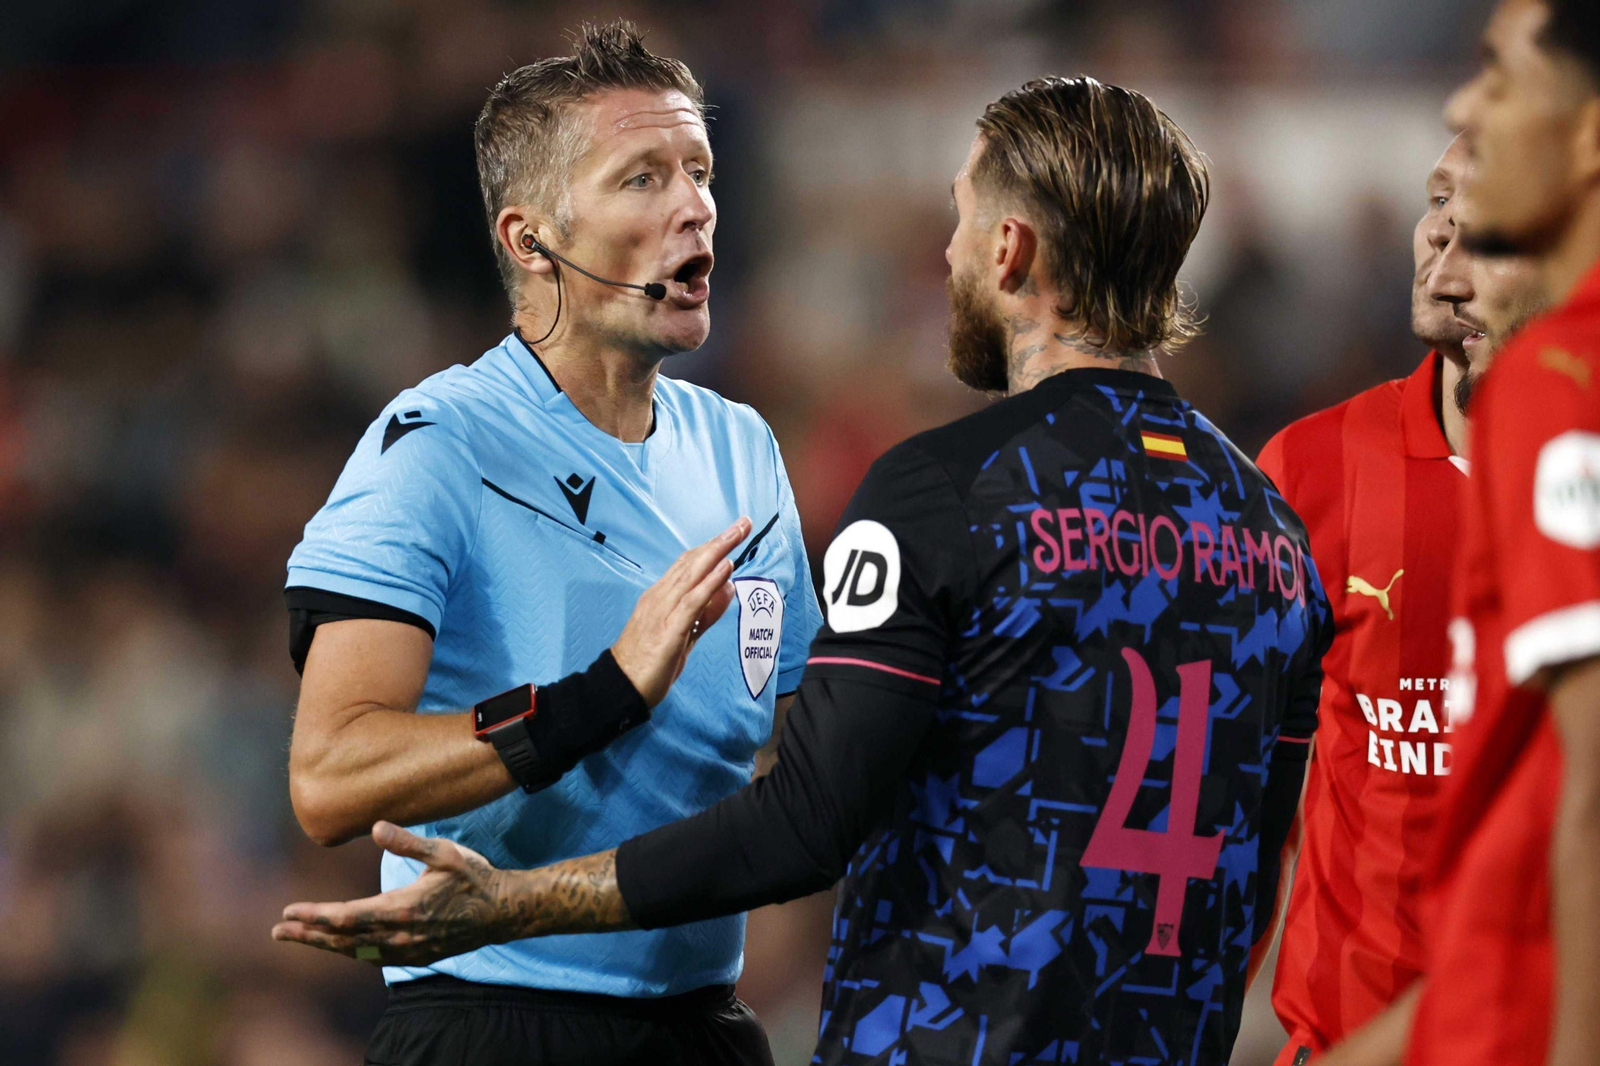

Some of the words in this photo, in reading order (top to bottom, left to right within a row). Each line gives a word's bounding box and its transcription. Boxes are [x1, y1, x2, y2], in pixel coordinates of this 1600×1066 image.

[1031, 508, 1183, 580] SERGIO
[832, 548, 888, 607] JD
[749, 592, 775, 613] UEFA
[744, 646, 773, 659] OFFICIAL
[749, 628, 774, 641] MATCH
[1079, 646, 1225, 957] 4
